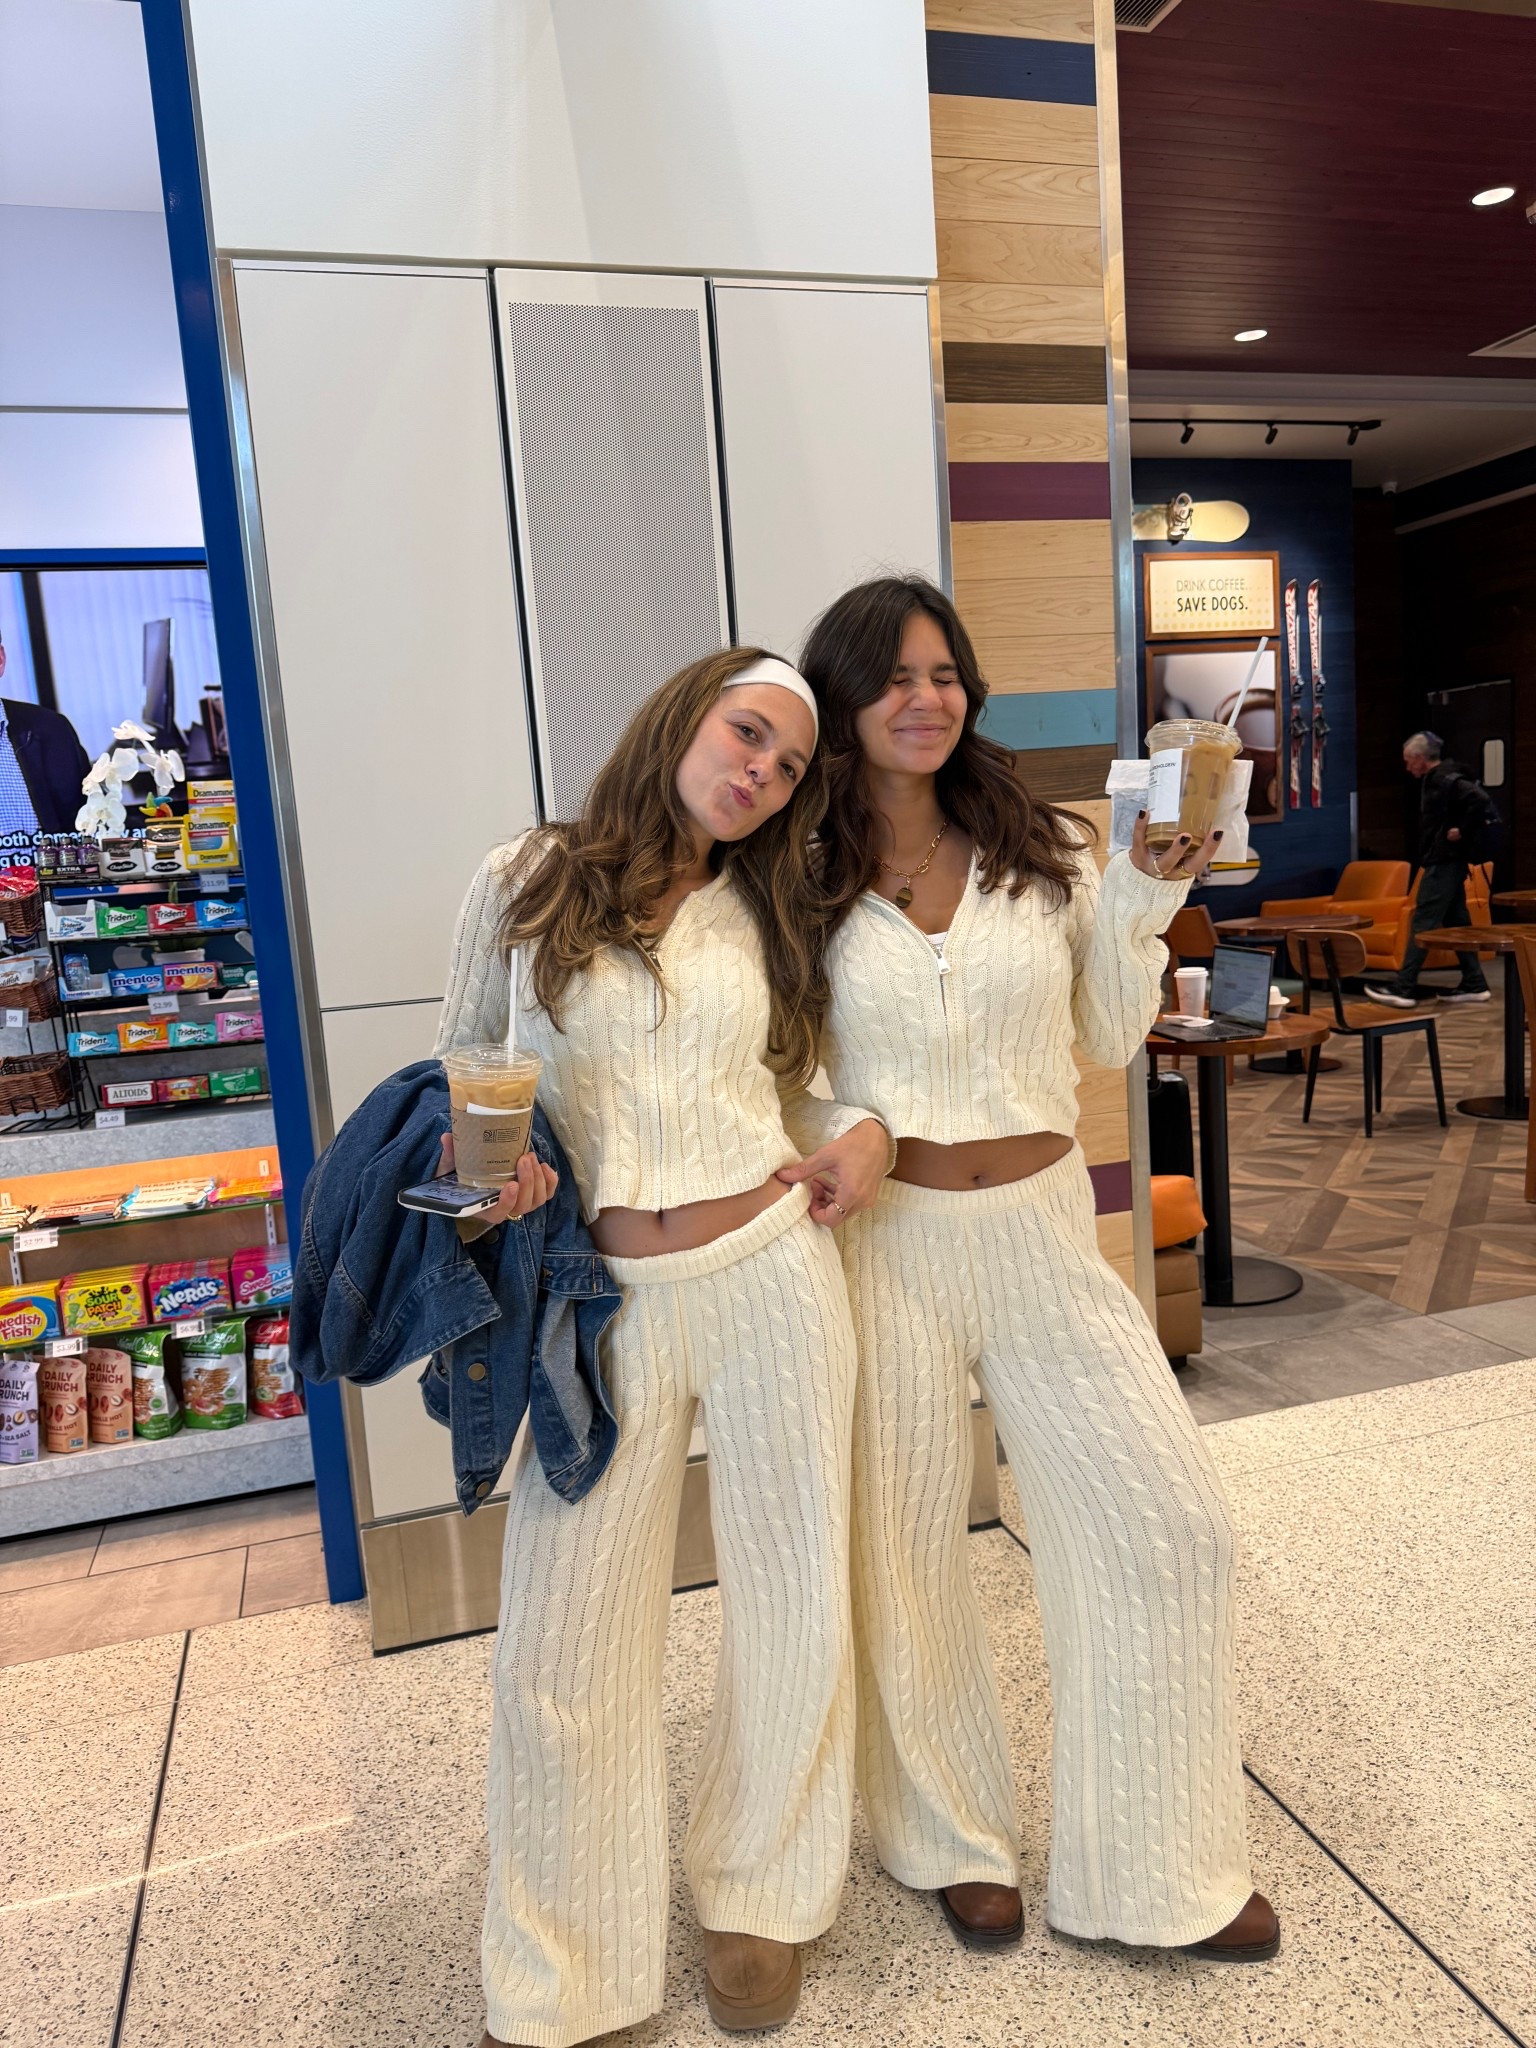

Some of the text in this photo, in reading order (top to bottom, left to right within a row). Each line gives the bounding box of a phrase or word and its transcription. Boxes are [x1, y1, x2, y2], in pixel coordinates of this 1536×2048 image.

[1176, 580, 1205, 592] DRINK
[1177, 596, 1248, 612] SAVE DOGS.
[188, 821, 230, 830] Dramamine
[0, 832, 29, 847] oth
[13, 856, 31, 867] to
[109, 862, 134, 871] ChapStick
[156, 910, 186, 919] Trident
[204, 906, 235, 915] Trident
[106, 914, 136, 923] Trident
[167, 965, 214, 976] mentos
[113, 974, 161, 986] mentos
[225, 1019, 254, 1027] Trident
[127, 1029, 157, 1038] Trident
[177, 1028, 206, 1037] Trident
[77, 1038, 107, 1046] Trident
[113, 1087, 149, 1098] ALTOIDS
[86, 1292, 118, 1307] SOUR
[86, 1302, 121, 1317] PATCH
[1, 1325, 32, 1341] Fish
[89, 1362, 117, 1373] DAILY
[44, 1371, 73, 1382] DAILY
[0, 1379, 26, 1390] DAILY
[109, 1413, 123, 1421] HOT
[64, 1422, 78, 1431] HOT
[15, 1430, 32, 1440] SALT
